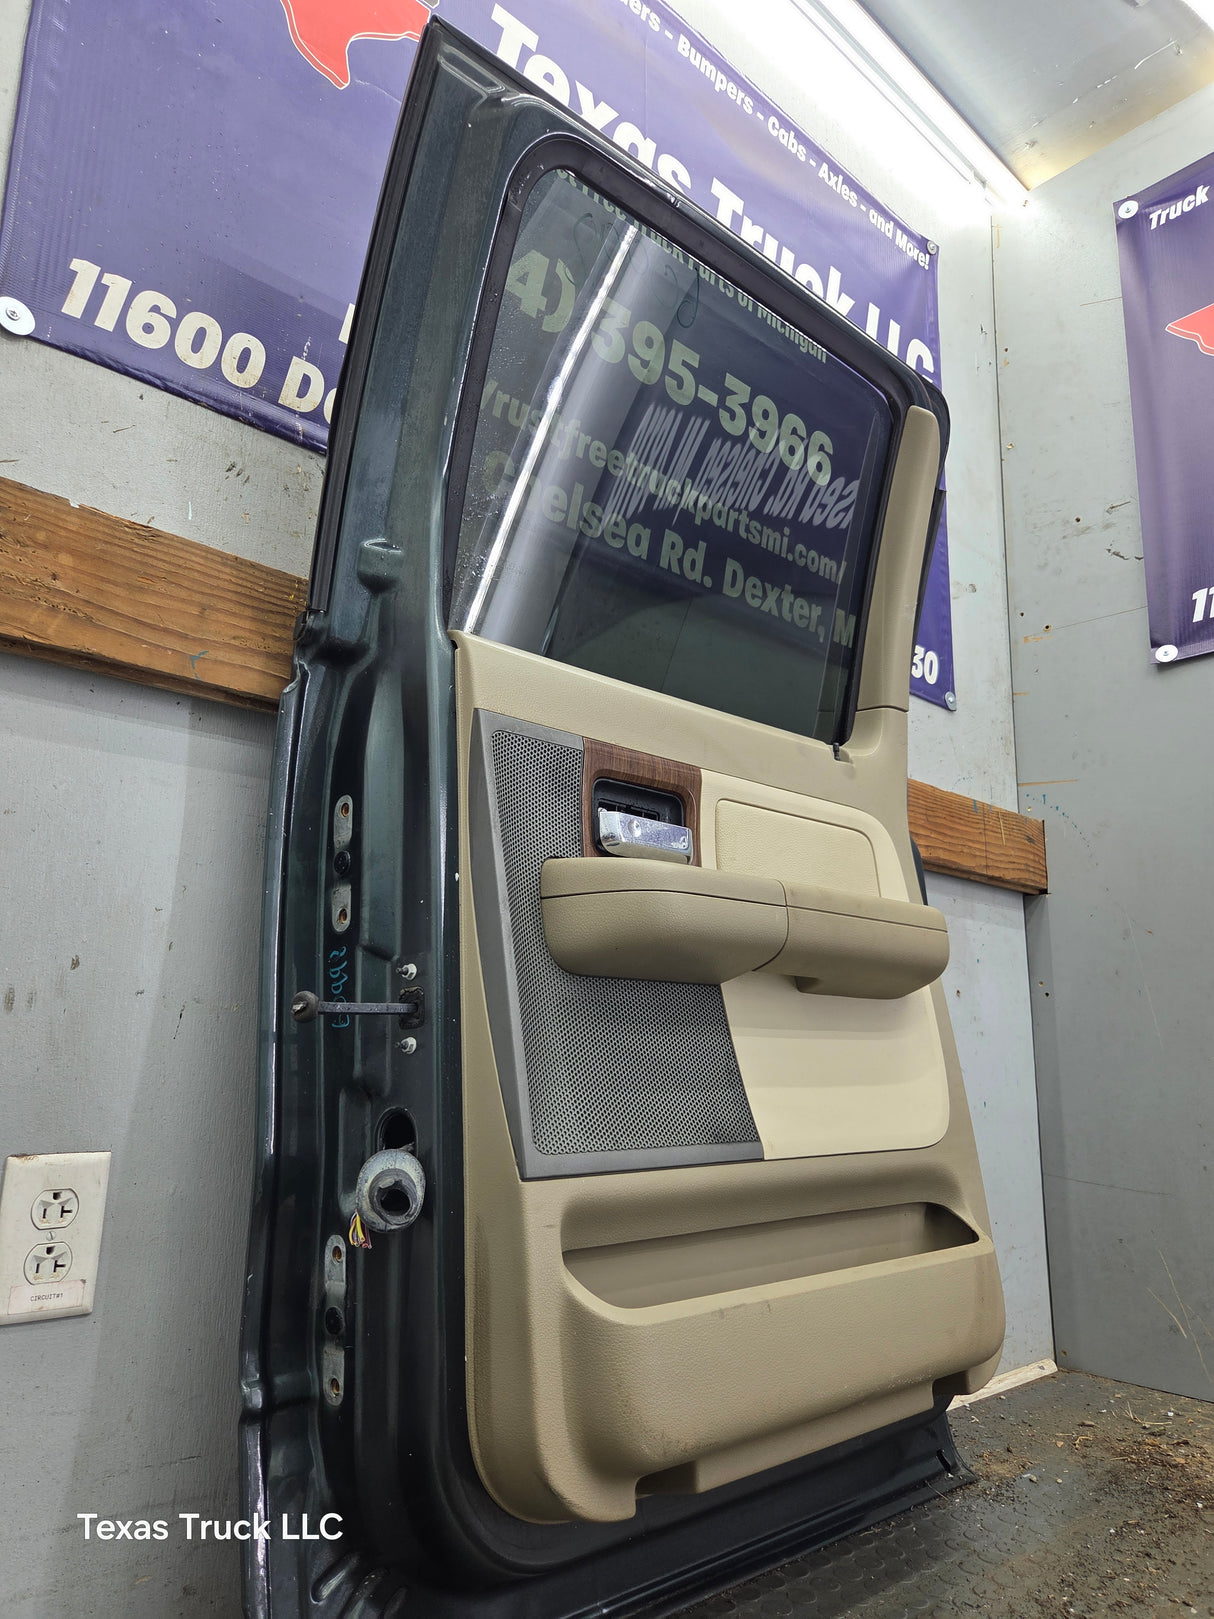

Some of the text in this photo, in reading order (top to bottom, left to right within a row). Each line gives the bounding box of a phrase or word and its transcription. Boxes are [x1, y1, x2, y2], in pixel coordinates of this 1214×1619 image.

[677, 33, 754, 115] Bumpers
[767, 115, 807, 162] Cabs
[818, 161, 859, 208] Axles
[869, 208, 894, 240] and
[895, 228, 930, 271] More!
[1149, 185, 1210, 230] Truck
[61, 257, 266, 389] 11600
[278, 355, 337, 425] D
[660, 528, 713, 588] Rd.
[722, 557, 825, 643] Dexter,
[591, 297, 834, 486] 395-3966
